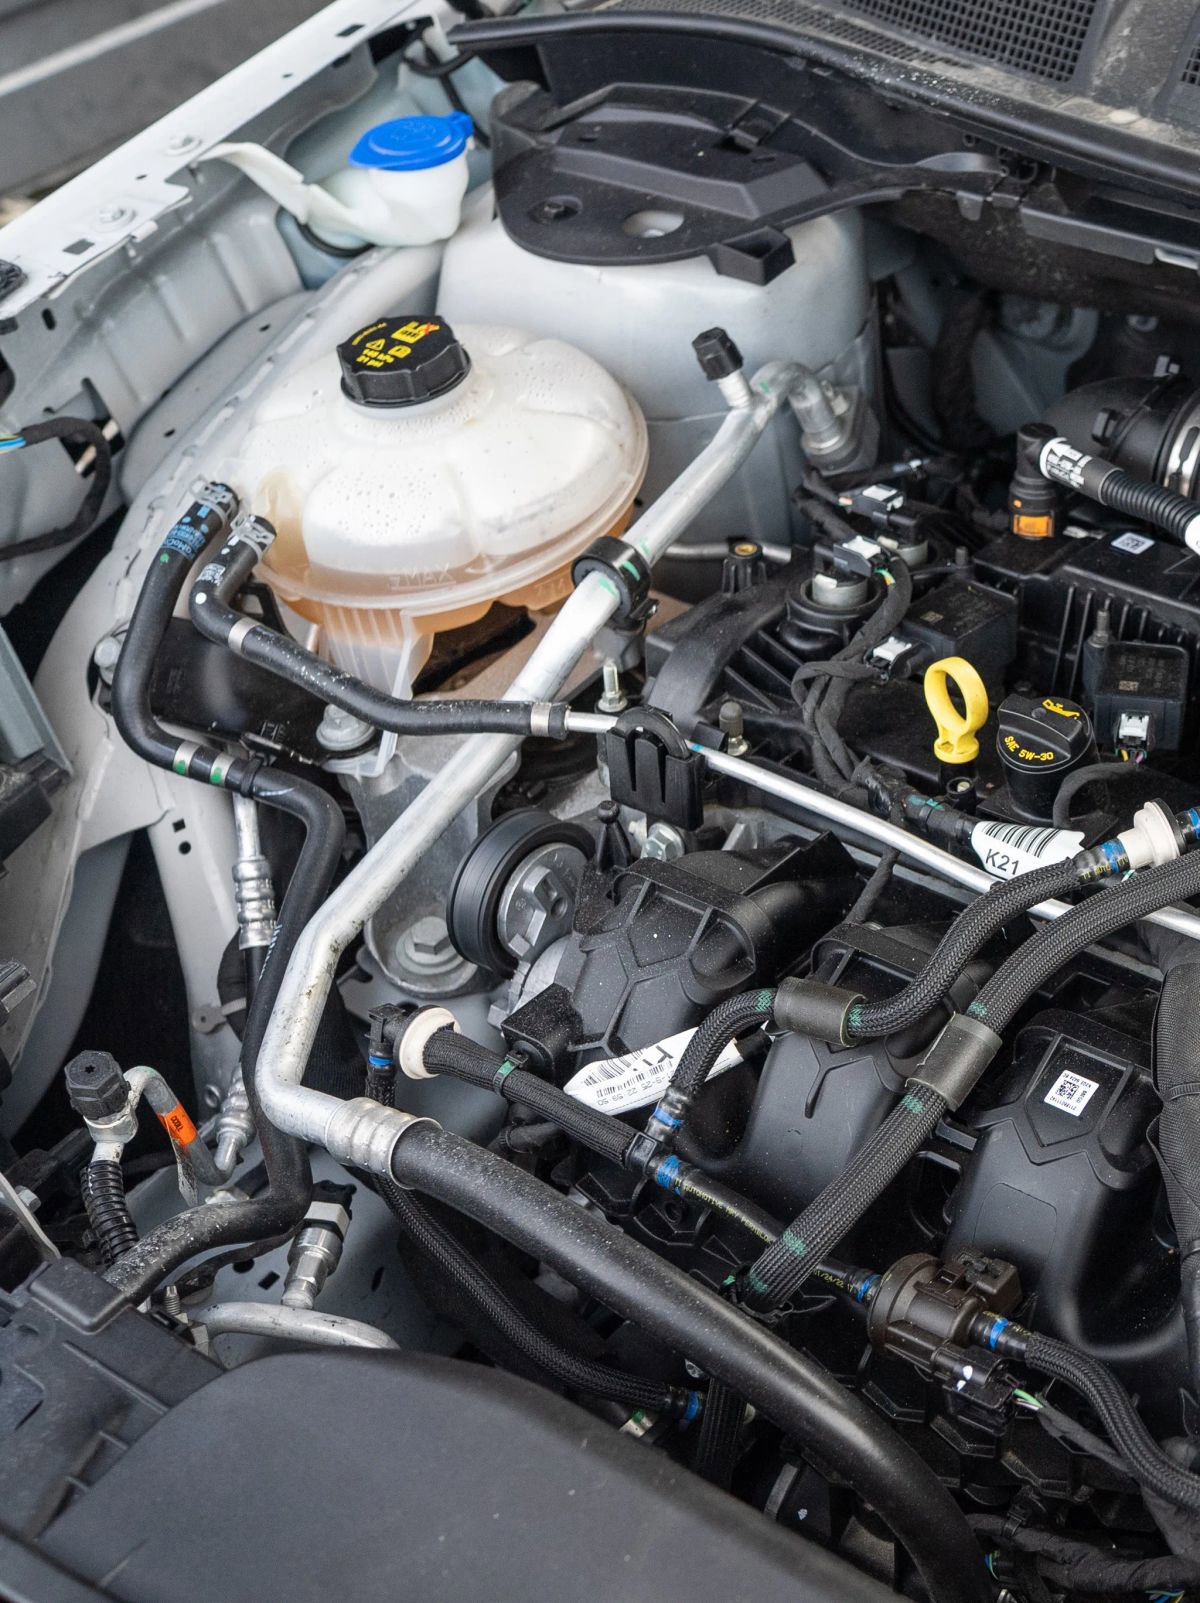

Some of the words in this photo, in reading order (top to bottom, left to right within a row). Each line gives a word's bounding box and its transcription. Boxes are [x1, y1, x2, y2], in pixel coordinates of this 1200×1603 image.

[402, 564, 456, 586] MAX
[1004, 736, 1020, 752] SAE
[1018, 749, 1054, 761] 5W-30
[986, 848, 1020, 876] K21
